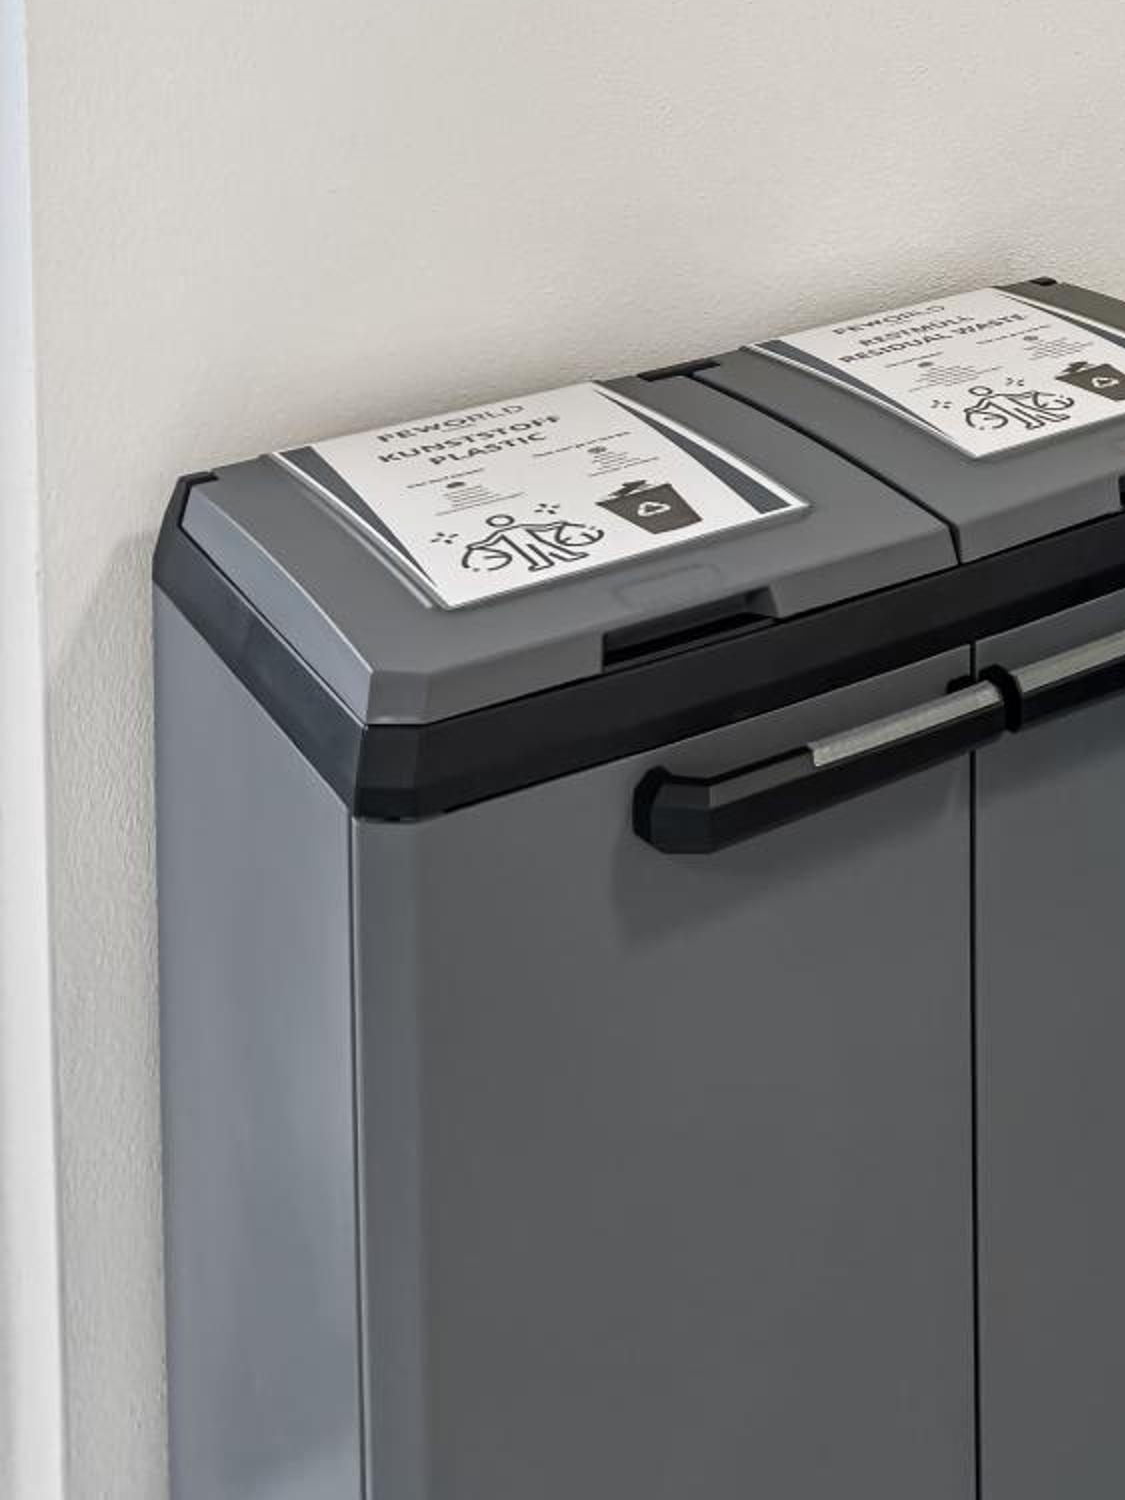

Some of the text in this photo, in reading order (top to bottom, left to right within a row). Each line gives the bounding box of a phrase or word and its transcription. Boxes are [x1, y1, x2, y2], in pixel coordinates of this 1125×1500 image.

[831, 305, 945, 335] FEWORLD
[838, 333, 954, 363] RESIDUAL
[951, 313, 1026, 335] WASTE
[376, 404, 526, 444] FEWORLD
[377, 414, 561, 464] KUNSTSTOFF
[429, 431, 547, 466] PLASTIC
